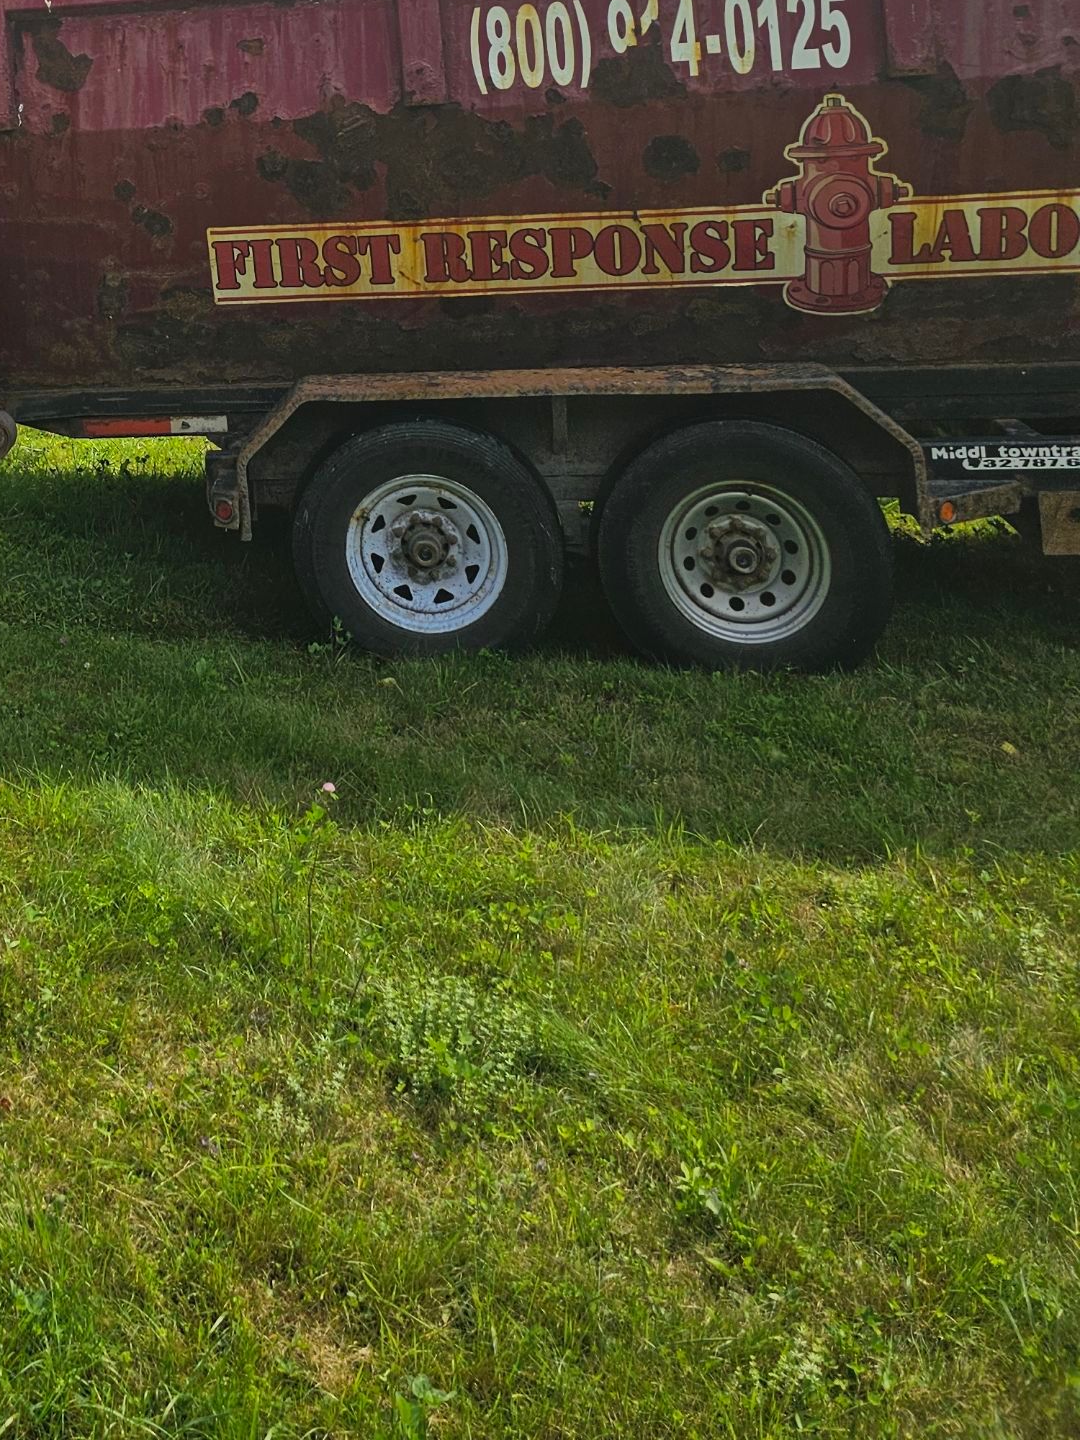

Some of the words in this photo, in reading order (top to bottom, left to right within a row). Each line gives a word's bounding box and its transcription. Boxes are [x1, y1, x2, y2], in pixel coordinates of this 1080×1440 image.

[470, 0, 592, 94] (800)
[212, 233, 400, 291] FIRST
[422, 218, 776, 284] RESPONSE
